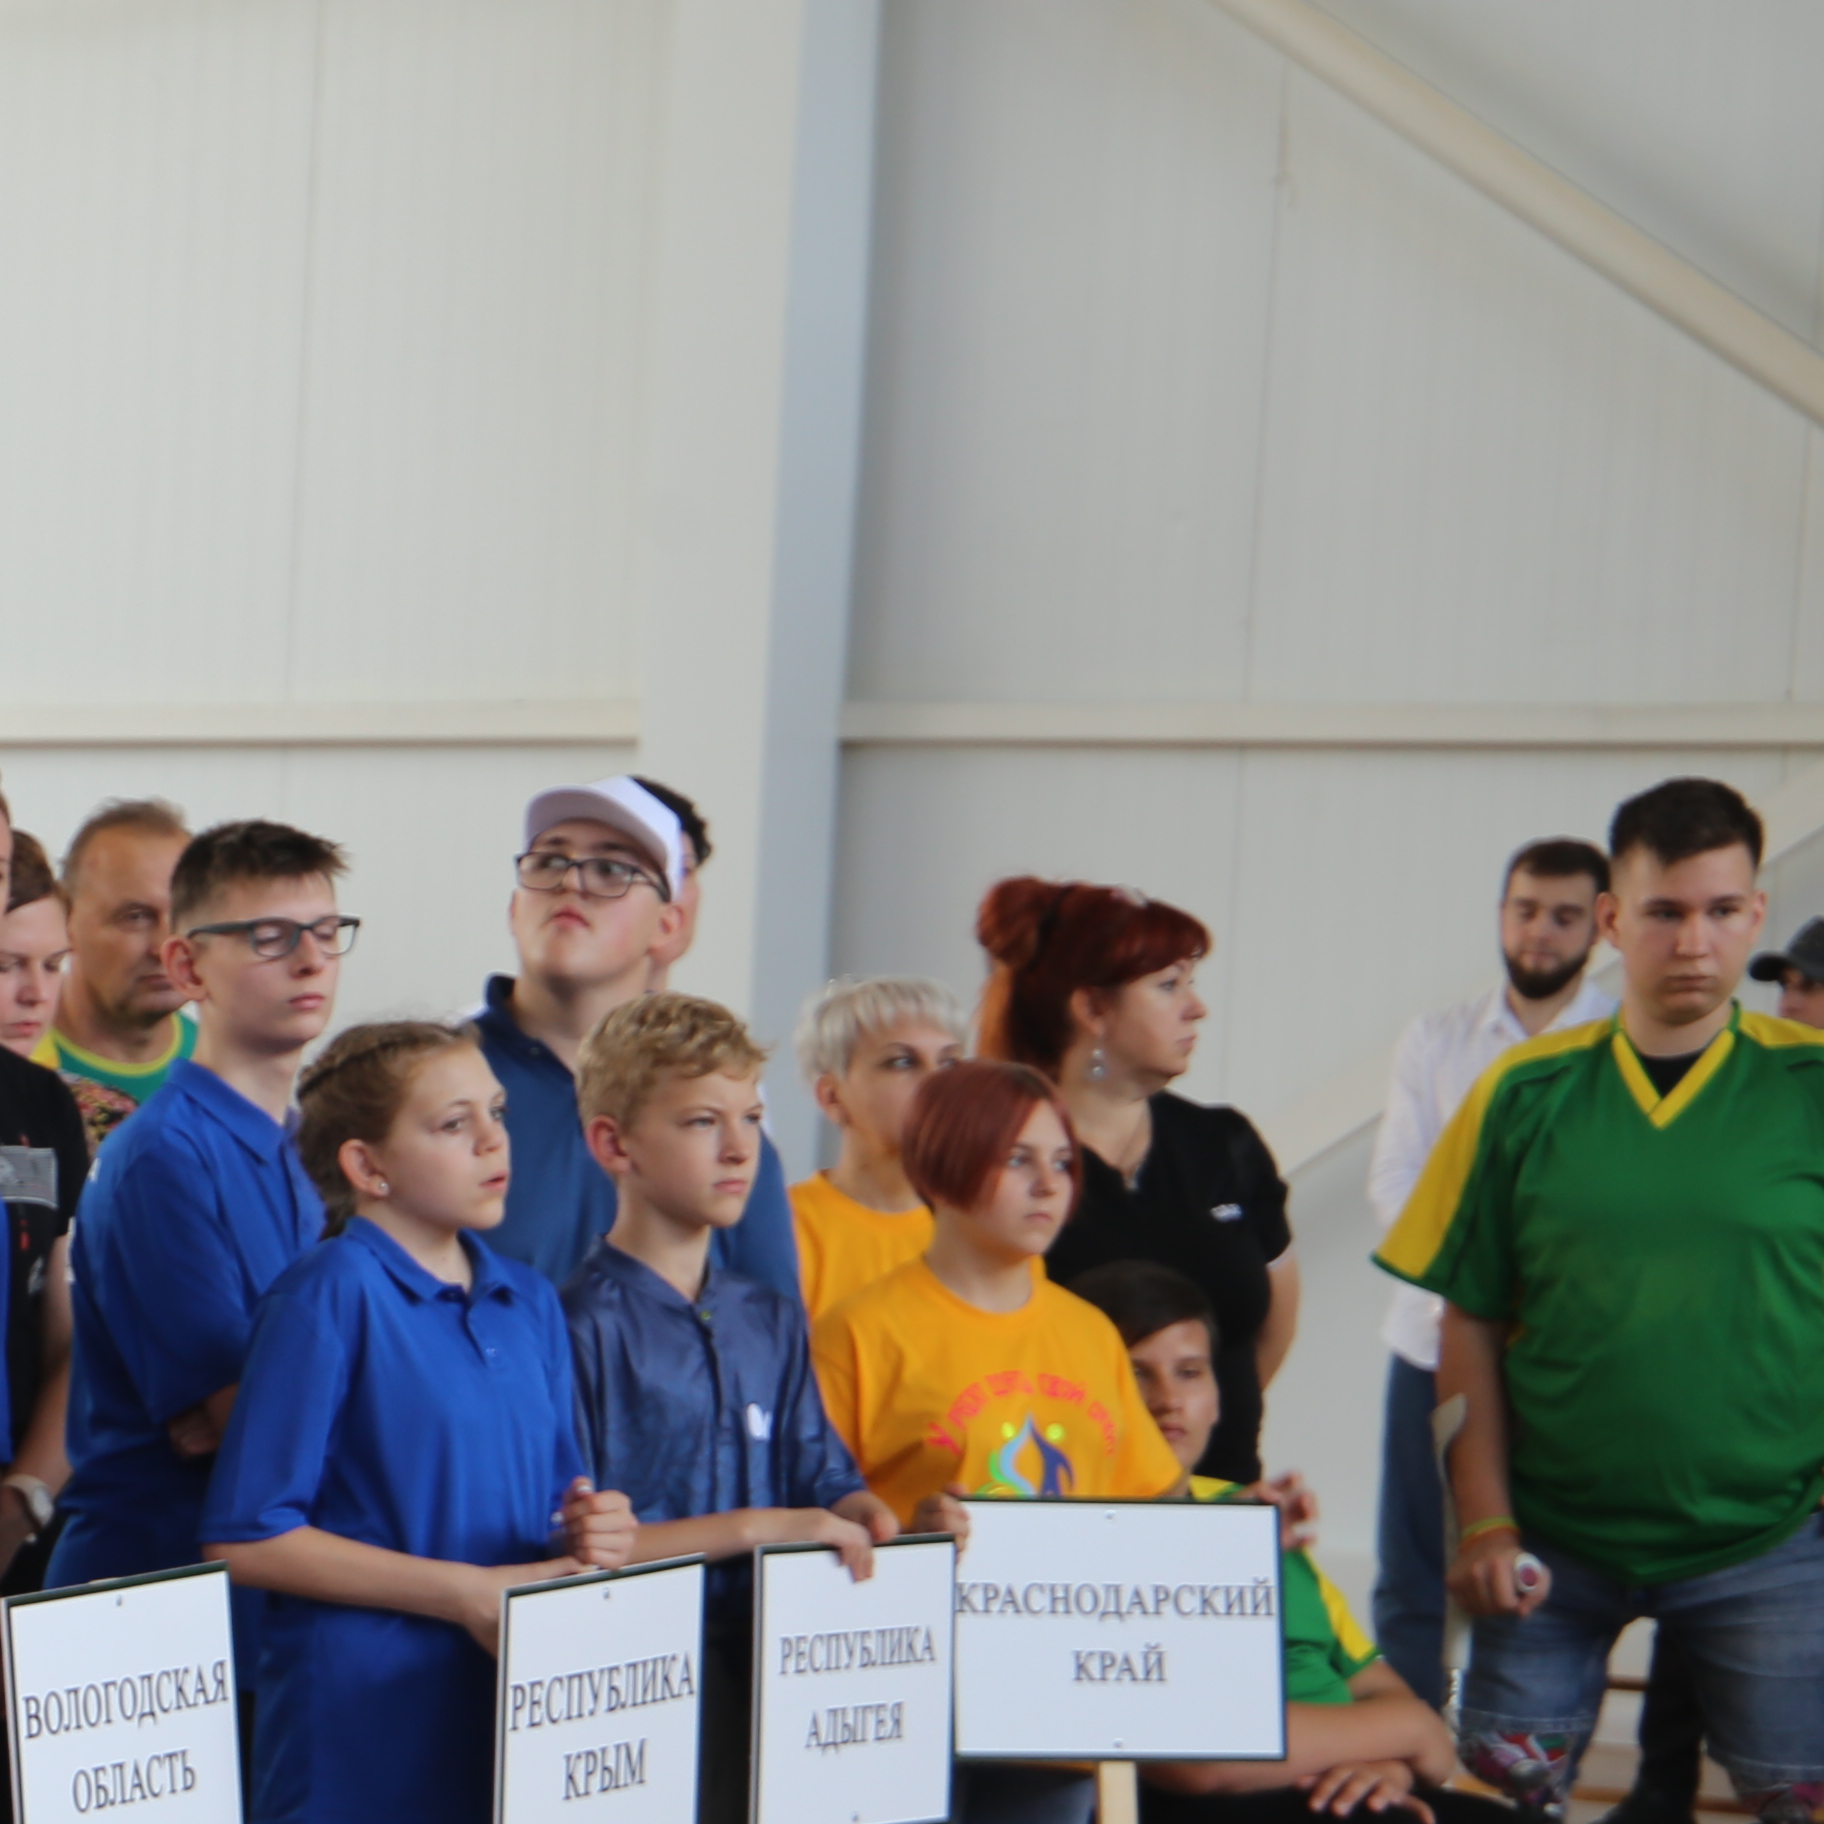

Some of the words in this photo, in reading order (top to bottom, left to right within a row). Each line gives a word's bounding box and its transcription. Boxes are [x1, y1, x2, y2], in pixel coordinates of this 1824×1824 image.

[955, 1576, 1275, 1622] КРАСНОДАРСКИЙ
[778, 1625, 936, 1676] РЕСПУБЛИКА
[1073, 1643, 1168, 1683] КРАЙ
[22, 1658, 230, 1740] ВОЛОГОДСКАЯ
[508, 1653, 696, 1733] РЕСПУБЛИКА
[804, 1700, 904, 1754] АДЫГЕЯ
[71, 1748, 197, 1814] ОБЛАСТЬ
[561, 1737, 648, 1802] КРЫМ
